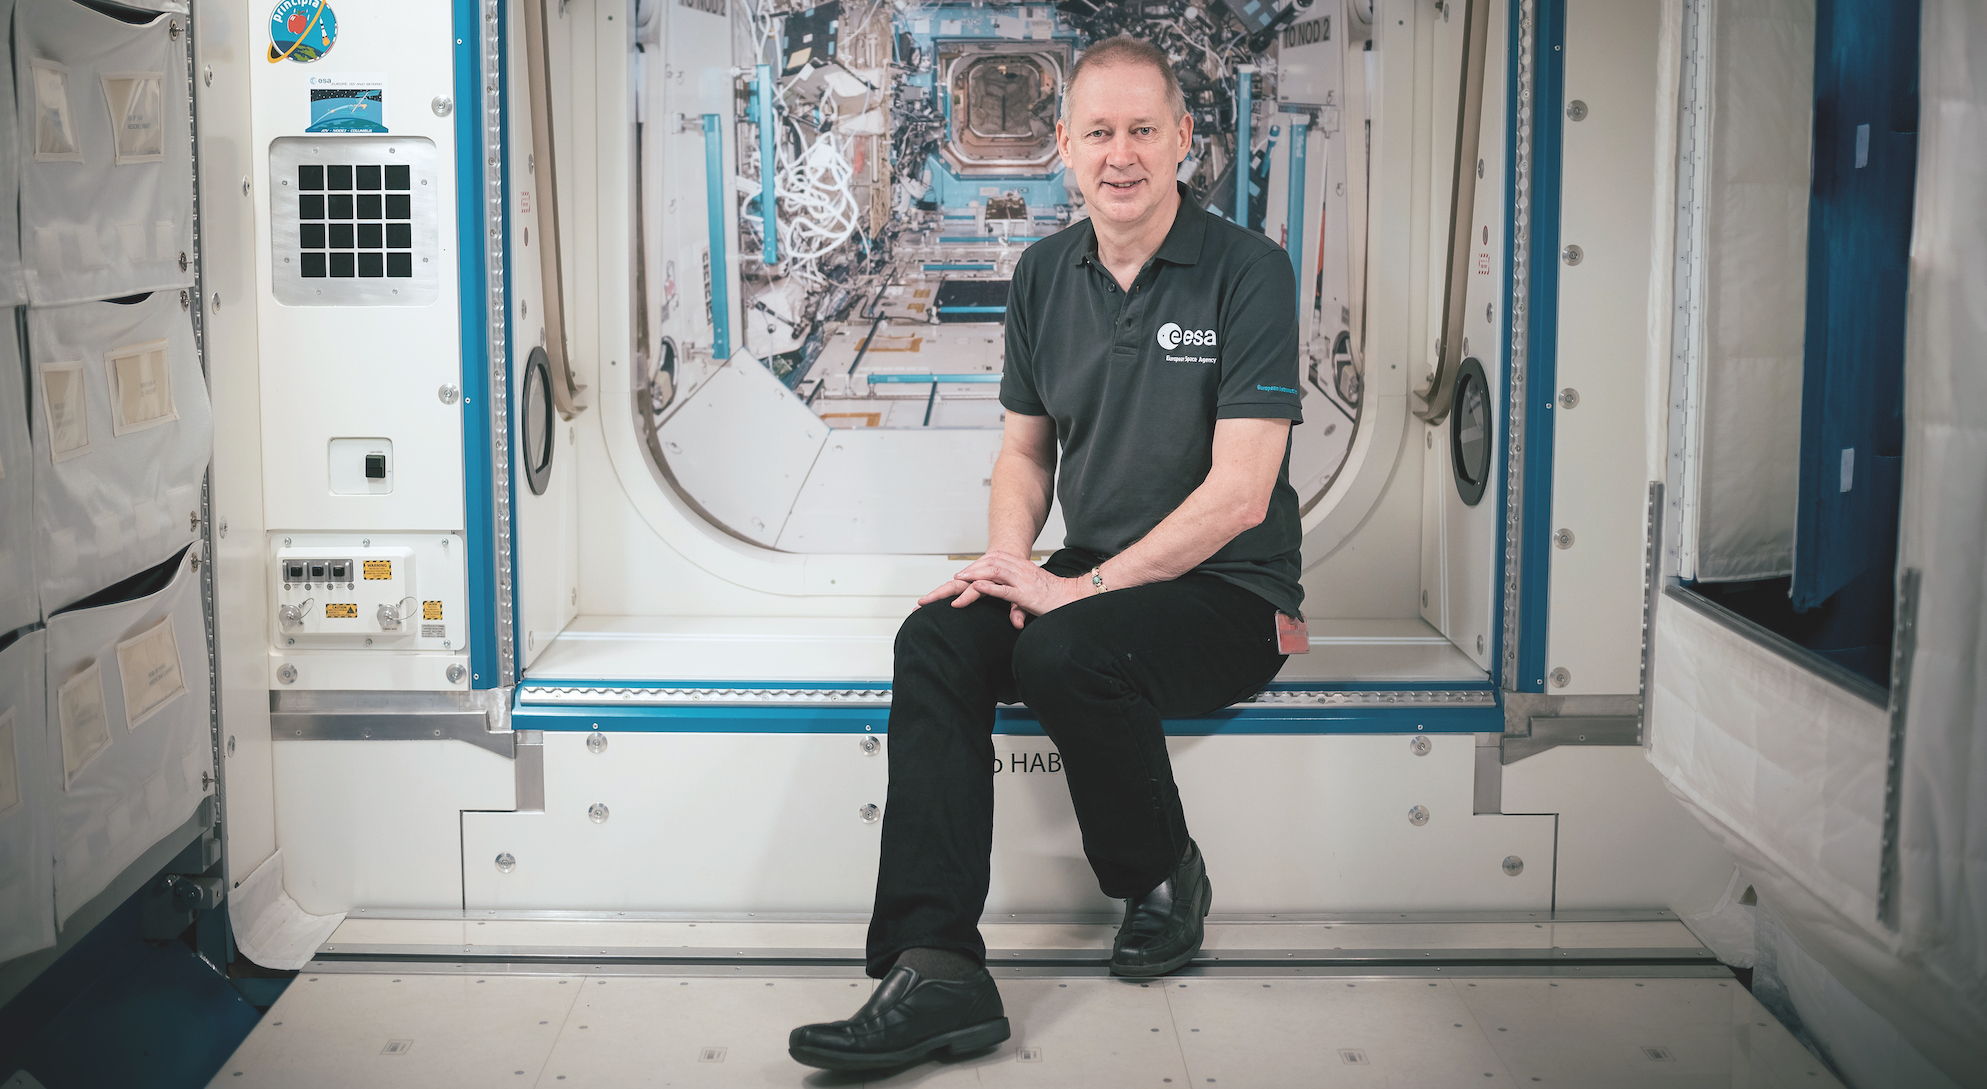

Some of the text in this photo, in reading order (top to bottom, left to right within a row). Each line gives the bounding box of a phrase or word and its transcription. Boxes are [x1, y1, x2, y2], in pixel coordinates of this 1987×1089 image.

[273, 0, 320, 23] principia
[1298, 20, 1320, 46] NOD
[1323, 17, 1330, 41] 2
[1165, 354, 1217, 364] European Space Agency
[1256, 384, 1279, 392] European
[1011, 753, 1062, 773] HAB
